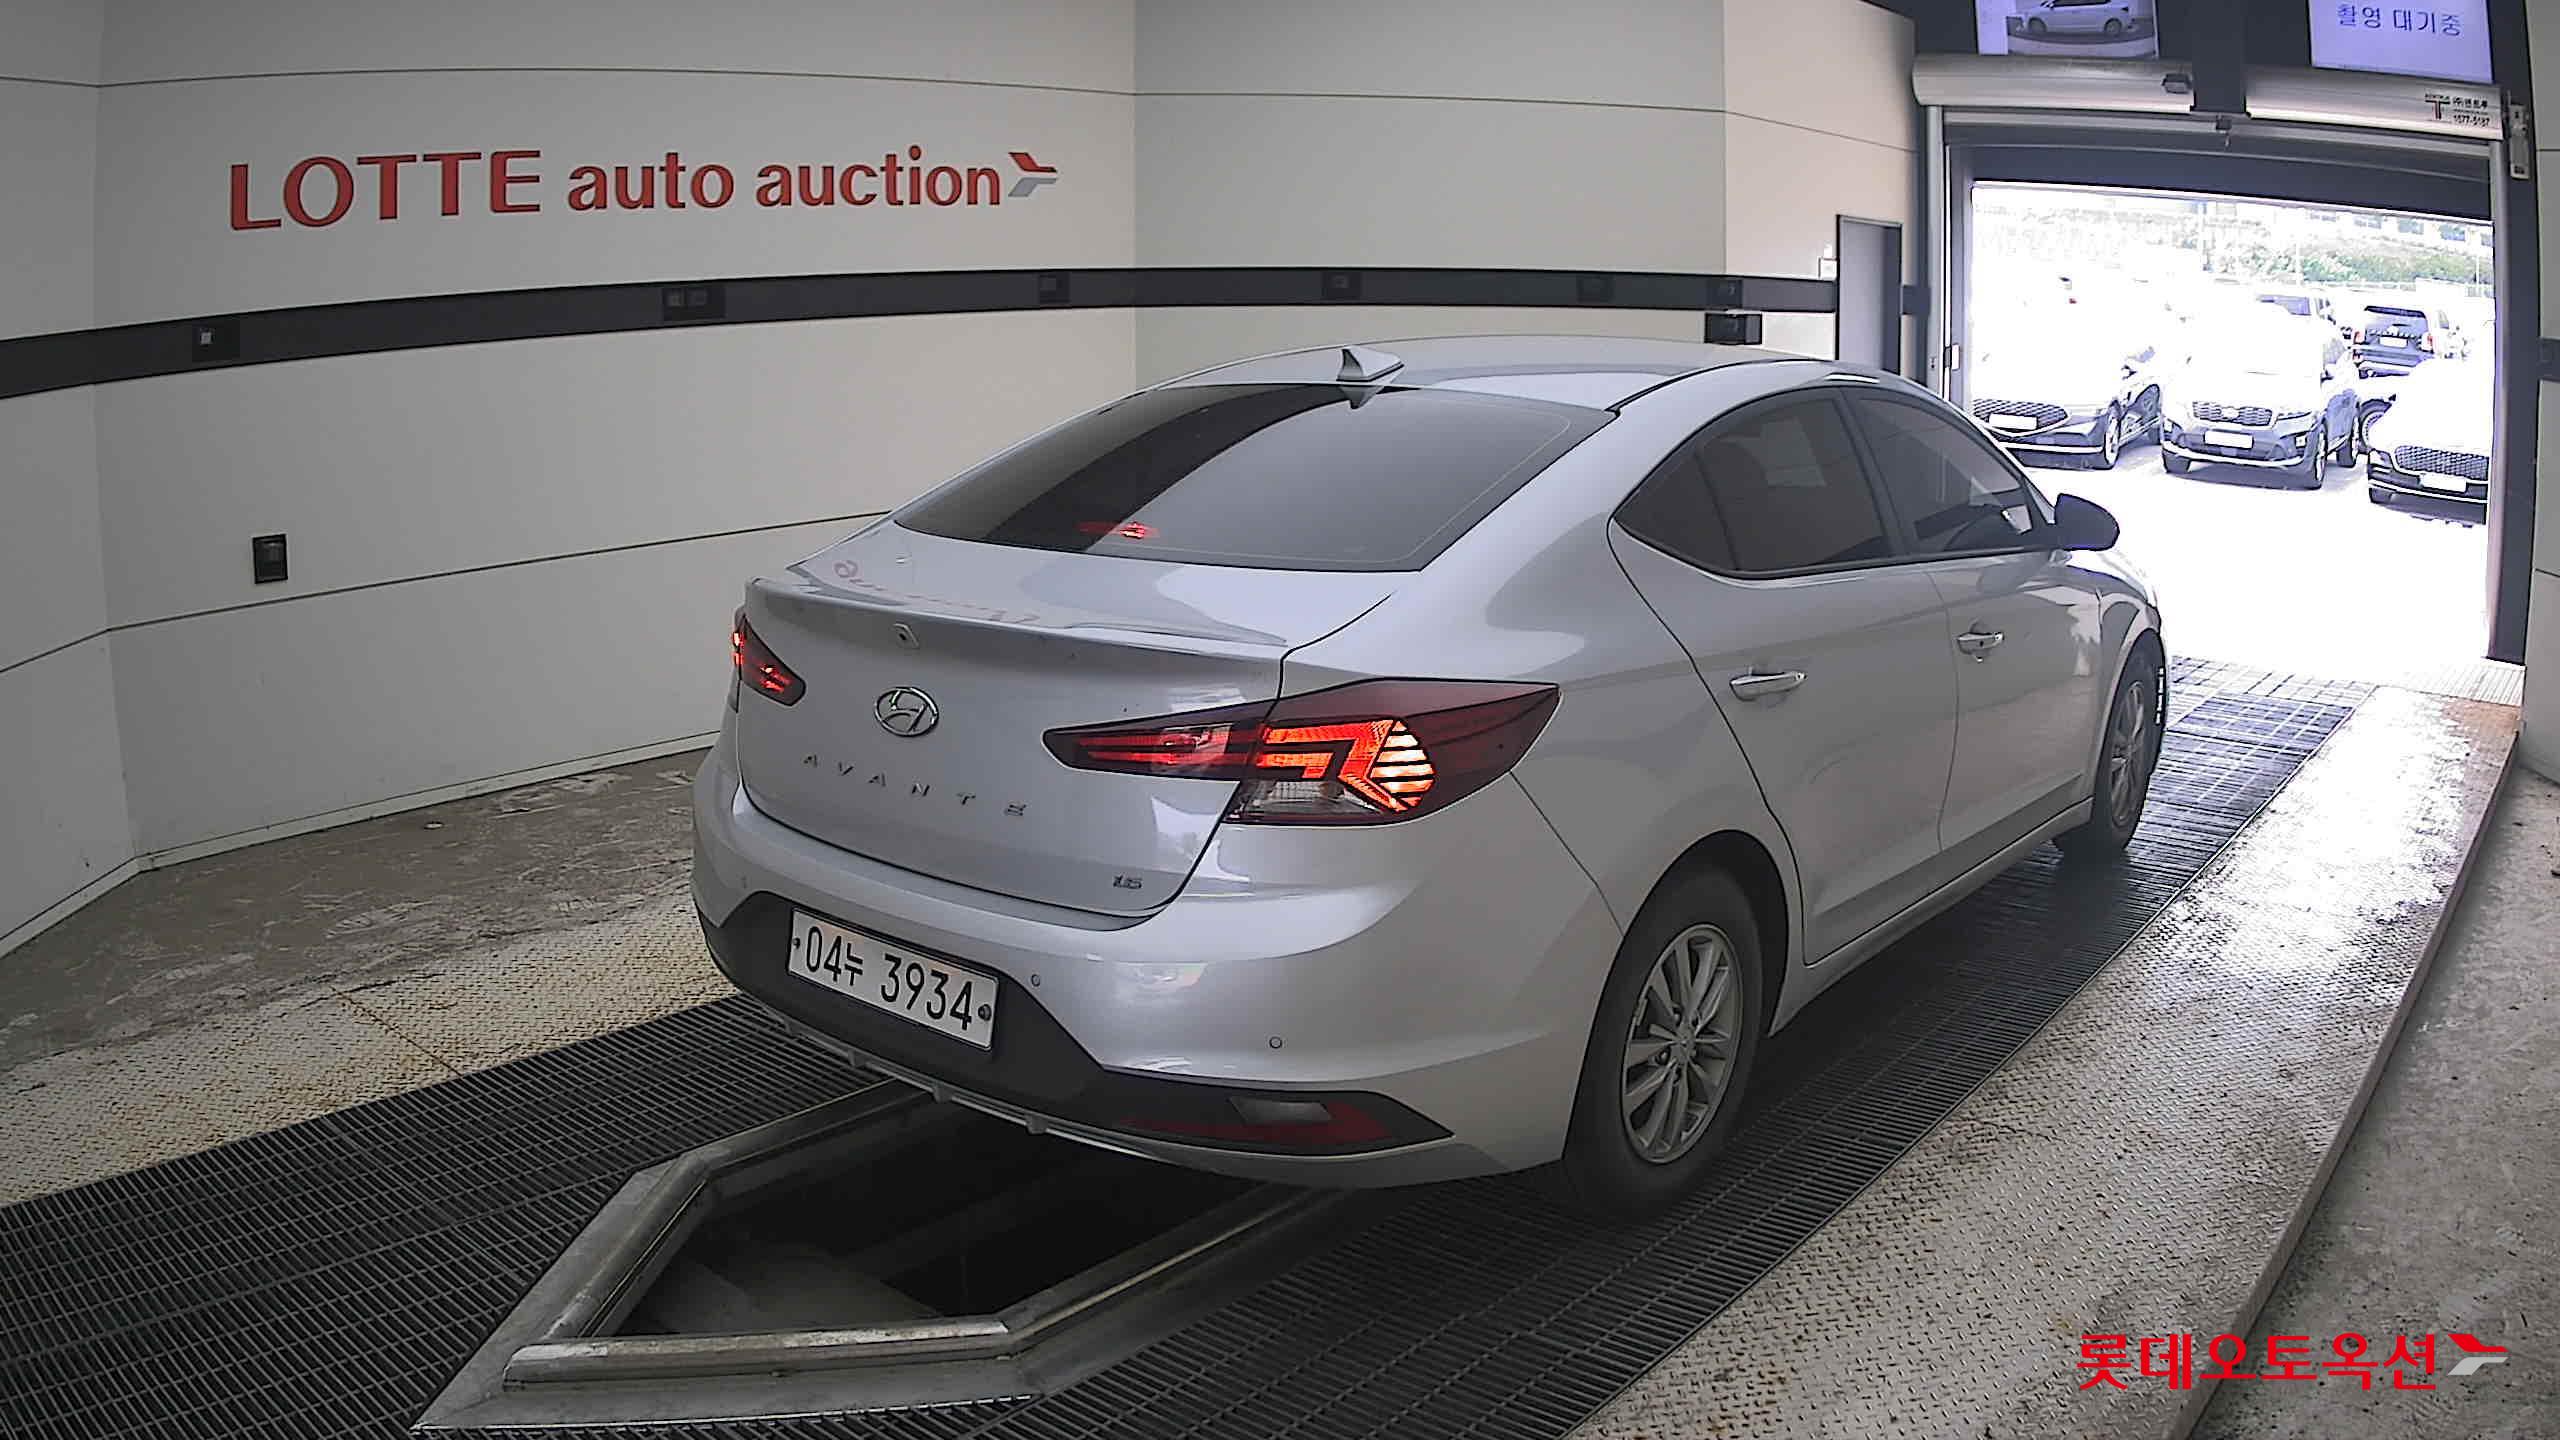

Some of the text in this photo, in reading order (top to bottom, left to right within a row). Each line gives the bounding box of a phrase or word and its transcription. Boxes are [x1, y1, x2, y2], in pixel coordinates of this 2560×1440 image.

[2393, 9, 2461, 37] 대기중
[231, 146, 1001, 231] LOTTE auto auction
[803, 754, 1027, 817] AVANTE
[806, 926, 973, 1030] 04누 3934
